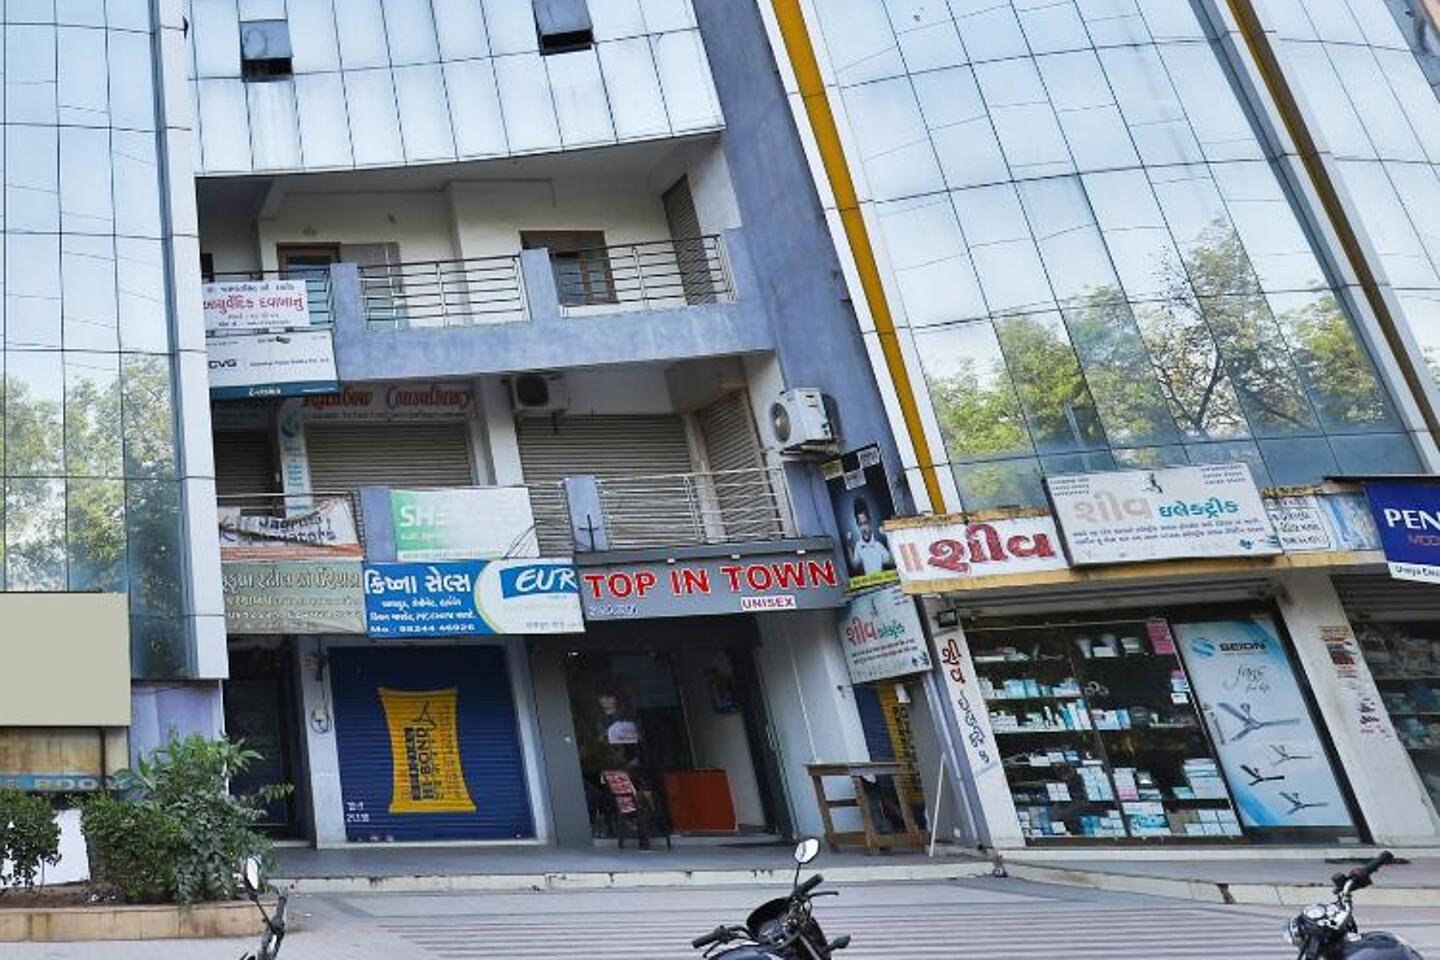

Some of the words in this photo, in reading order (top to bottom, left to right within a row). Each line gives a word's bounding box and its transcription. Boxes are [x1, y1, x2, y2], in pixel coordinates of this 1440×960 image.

[584, 572, 656, 599] TOP
[671, 568, 710, 597] IN
[721, 559, 837, 593] TOWN
[742, 596, 795, 609] UNISEX
